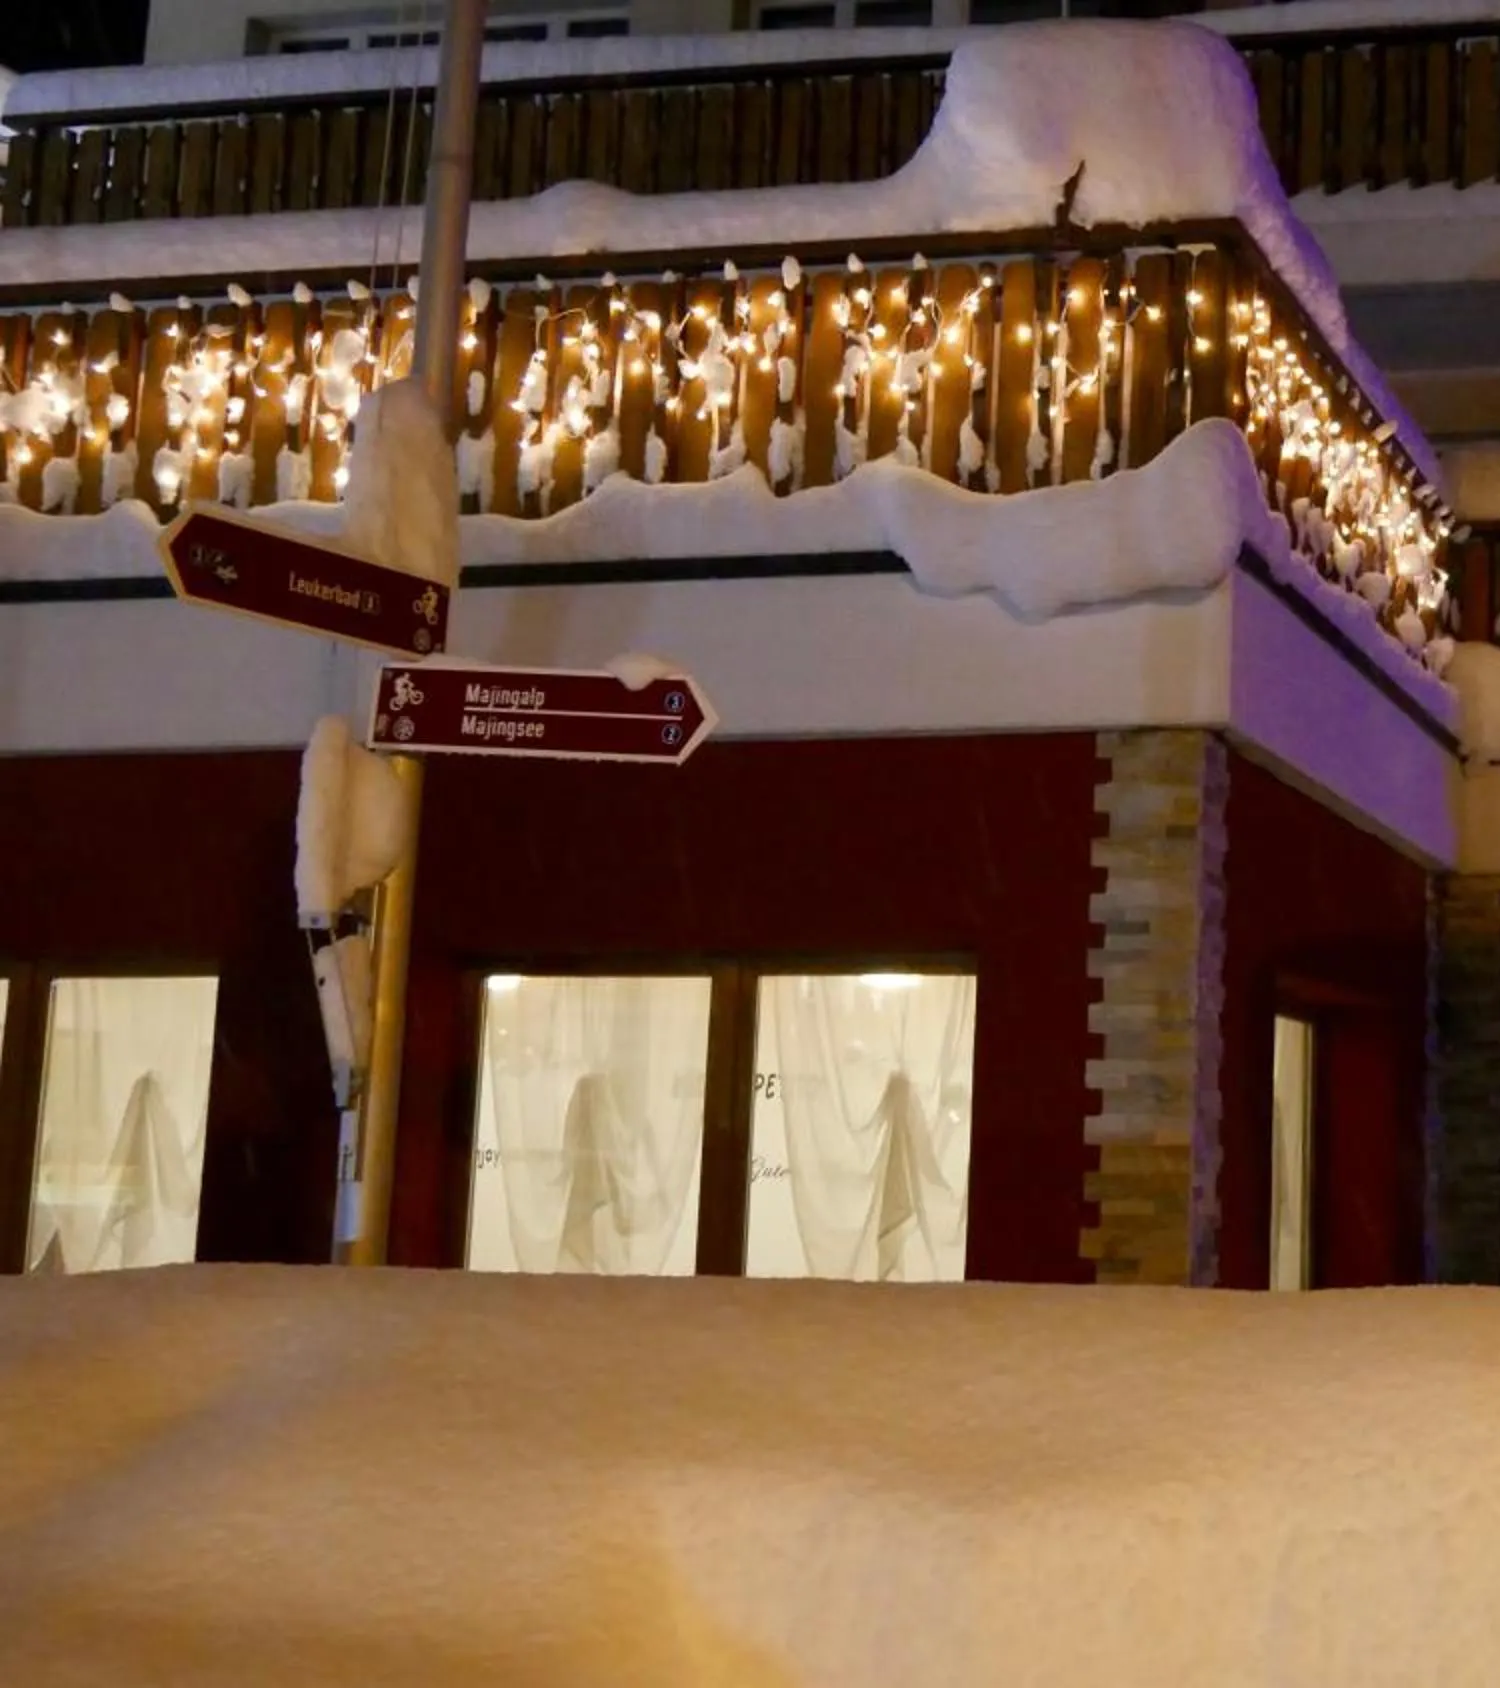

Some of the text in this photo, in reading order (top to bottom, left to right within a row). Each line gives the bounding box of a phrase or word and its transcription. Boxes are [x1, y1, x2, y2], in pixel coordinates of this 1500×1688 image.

[287, 569, 362, 610] Leukerbad
[464, 683, 546, 711] Majingalp
[461, 714, 546, 741] Majingsee
